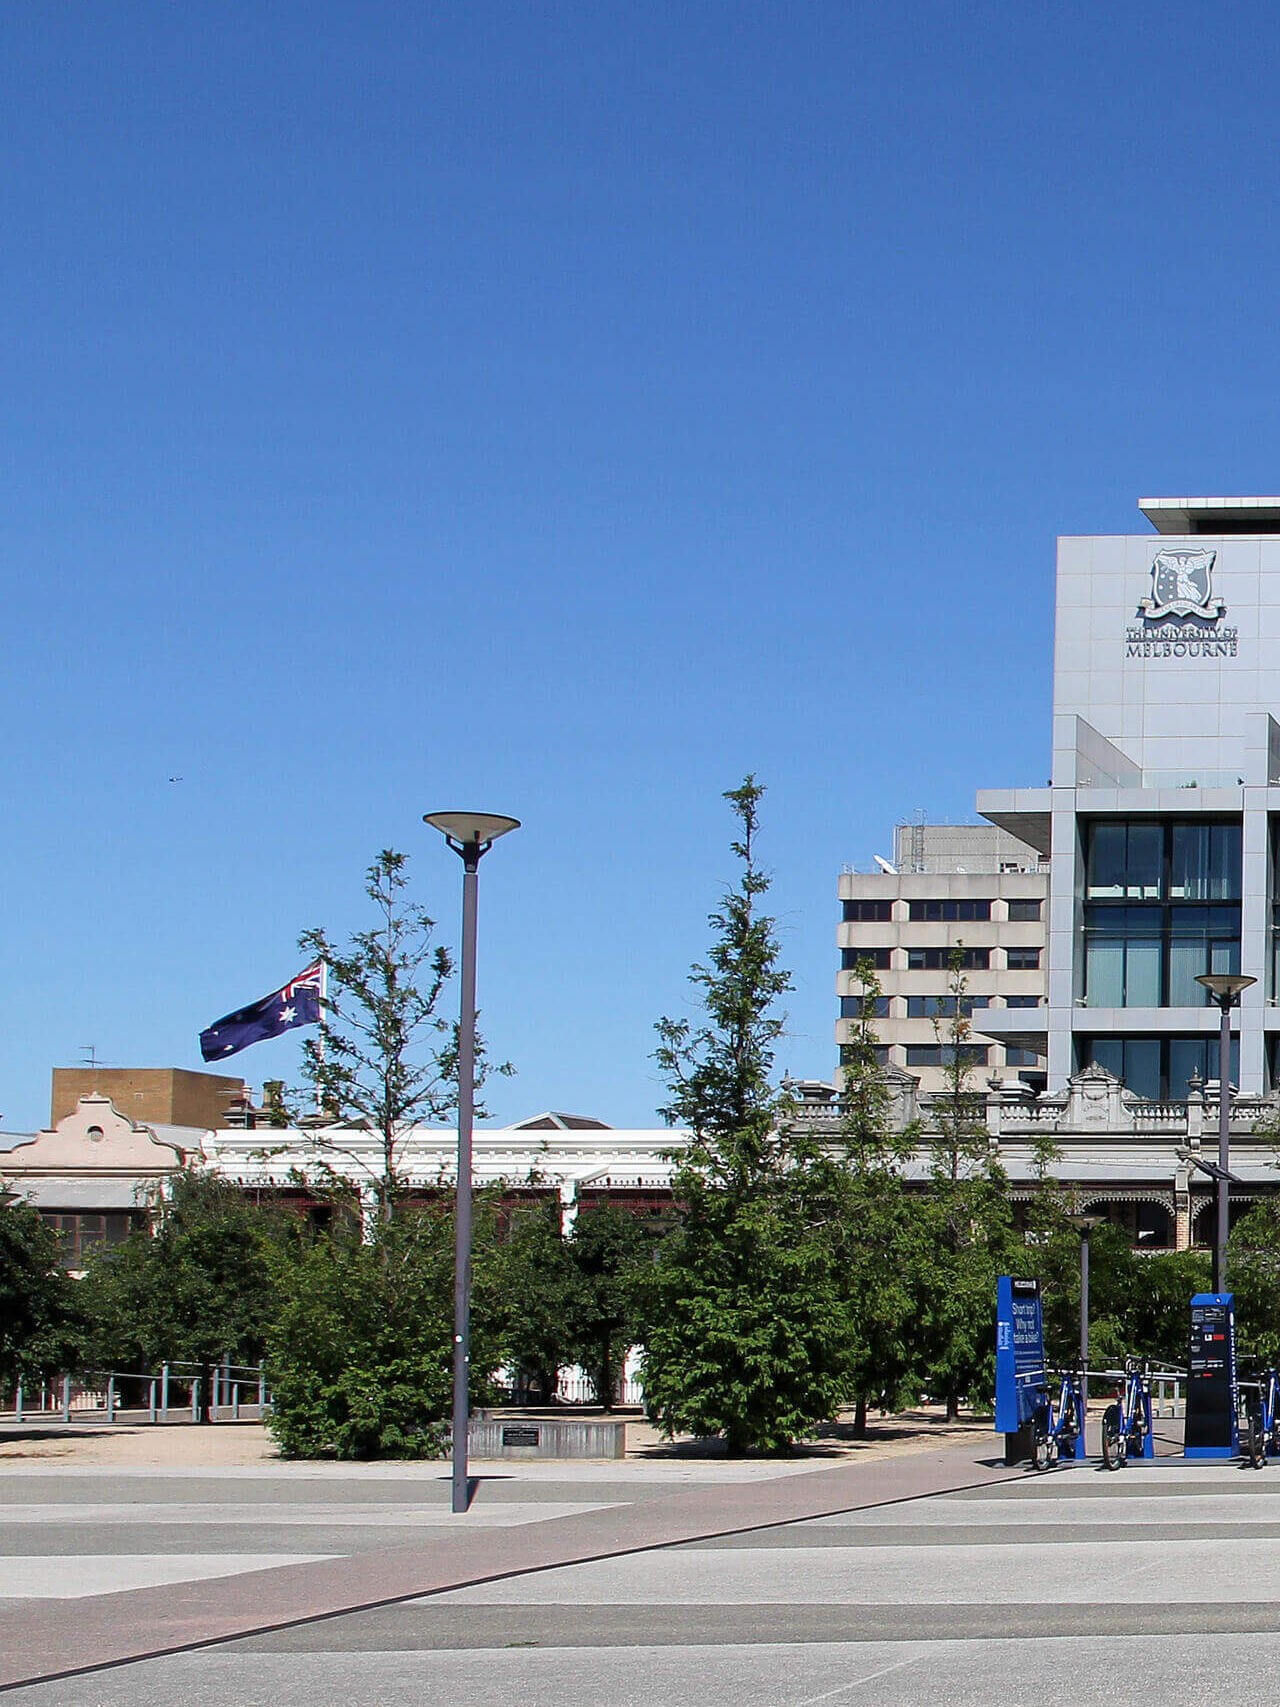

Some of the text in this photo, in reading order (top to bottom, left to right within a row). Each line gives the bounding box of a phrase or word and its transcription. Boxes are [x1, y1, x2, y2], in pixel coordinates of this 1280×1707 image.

[1149, 627, 1221, 639] UNIVERSITY
[1222, 627, 1239, 639] OF
[1126, 643, 1238, 657] MELBOURNE
[1012, 1303, 1025, 1315] Short
[1016, 1318, 1027, 1332] Why
